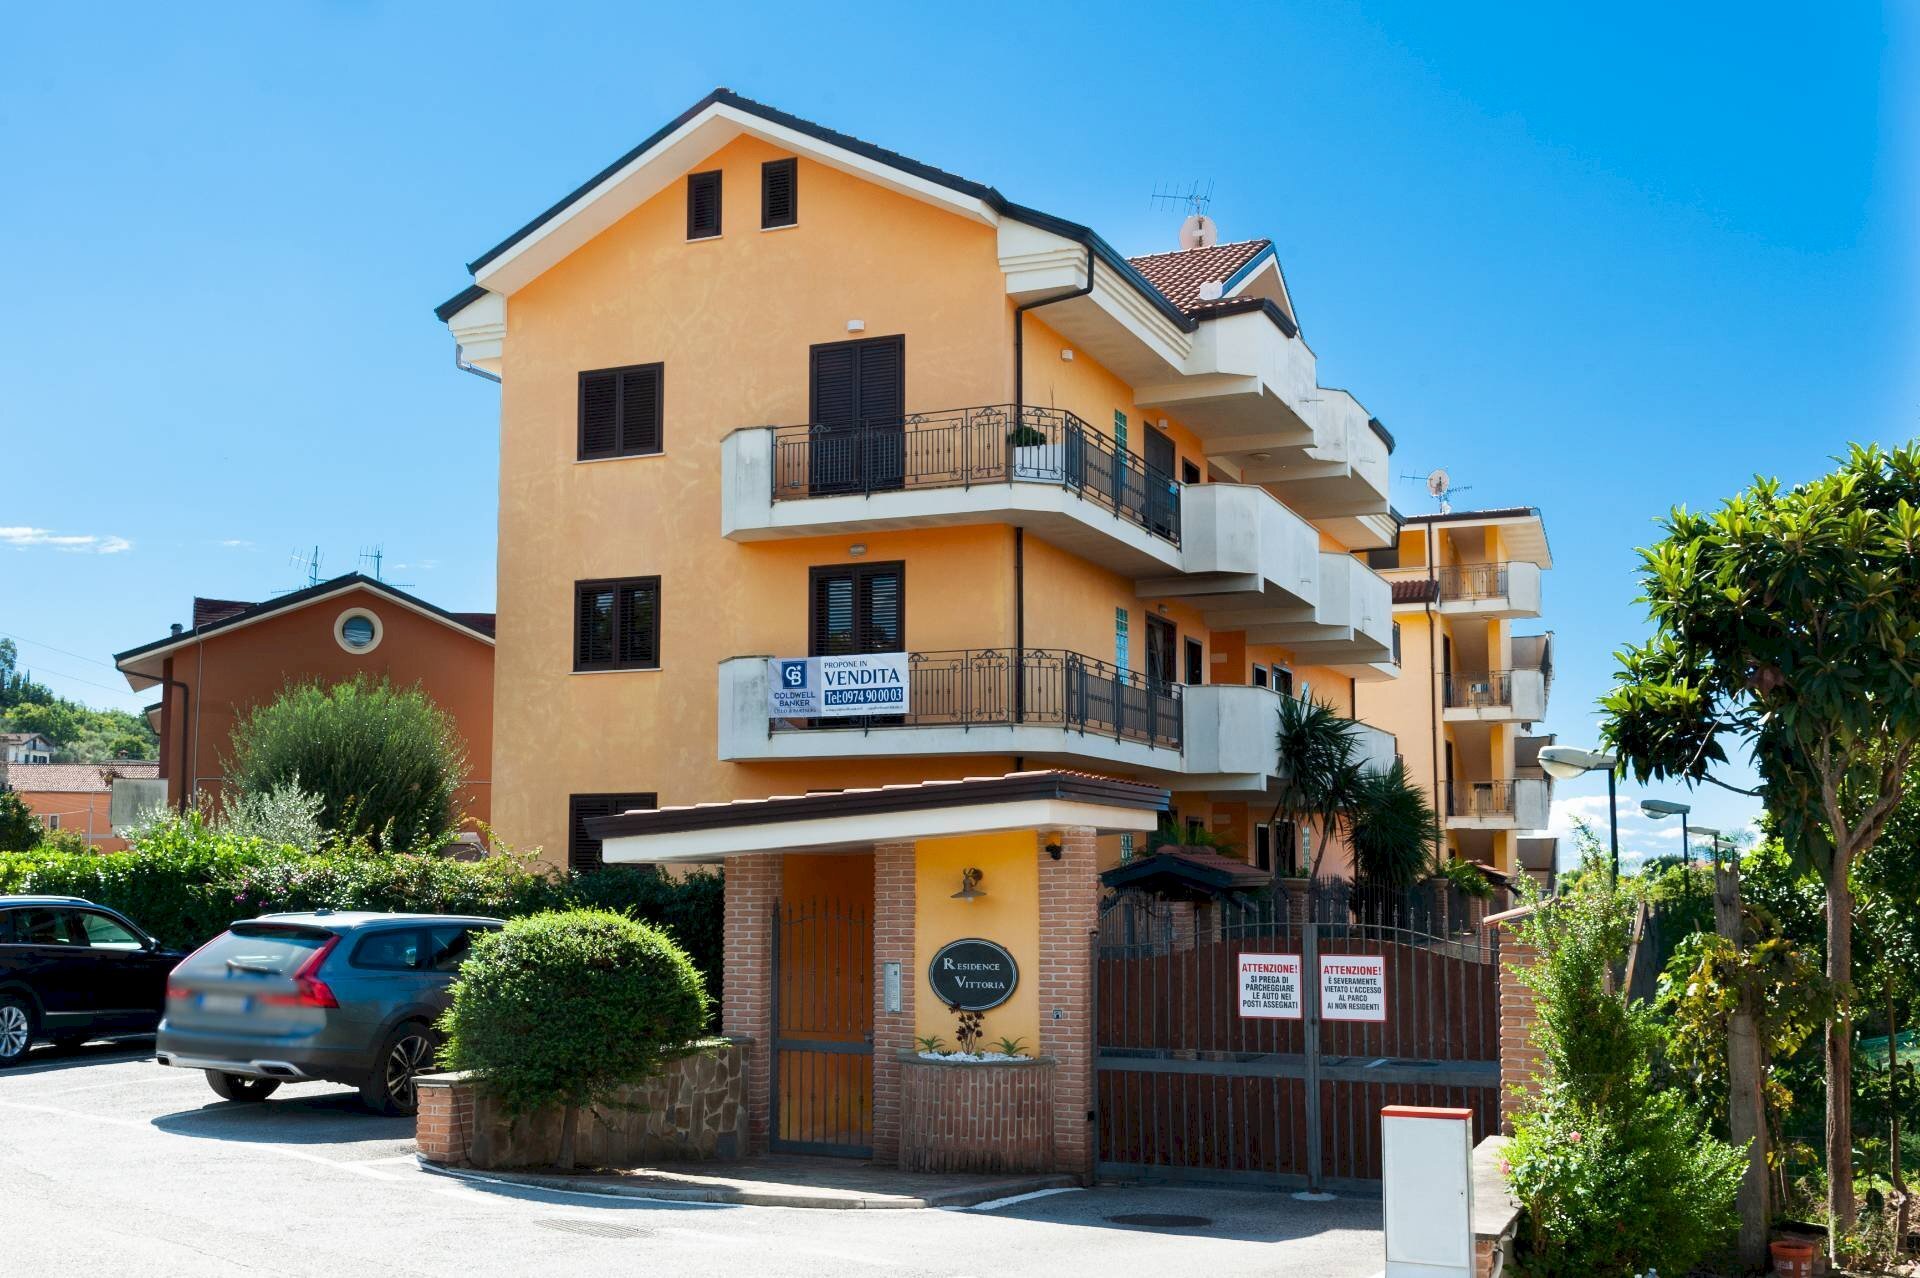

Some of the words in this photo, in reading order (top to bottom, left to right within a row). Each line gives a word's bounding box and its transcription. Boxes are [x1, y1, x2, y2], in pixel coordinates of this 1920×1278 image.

[824, 667, 900, 686] VENDITA
[774, 691, 816, 699] COLDWELL
[866, 690, 877, 702] 90
[878, 689, 889, 702] 00
[890, 688, 901, 701] 03
[1242, 963, 1298, 973] ATTENZIONE!
[1323, 965, 1382, 975] ATTENZIONE!
[1250, 975, 1257, 983] SI
[1258, 975, 1281, 984] PREGA
[1282, 976, 1288, 984] DI
[1328, 976, 1332, 984] È
[1333, 977, 1377, 985] SEVERAMENTE
[1245, 983, 1295, 992] PARCHEGGIARE
[1324, 985, 1349, 993] VIETATO
[1349, 986, 1382, 994] L'ACCESSO
[1252, 992, 1260, 1000] LE
[1261, 992, 1279, 1001] AUTO
[1280, 992, 1292, 1001] NEI
[1347, 994, 1368, 1002] PARCO
[1242, 1000, 1262, 1008] POSTI
[1262, 1000, 1298, 1009] ASSEGNATI
[1334, 1002, 1347, 1010] NON
[1348, 1003, 1380, 1011] RESIDENTI
